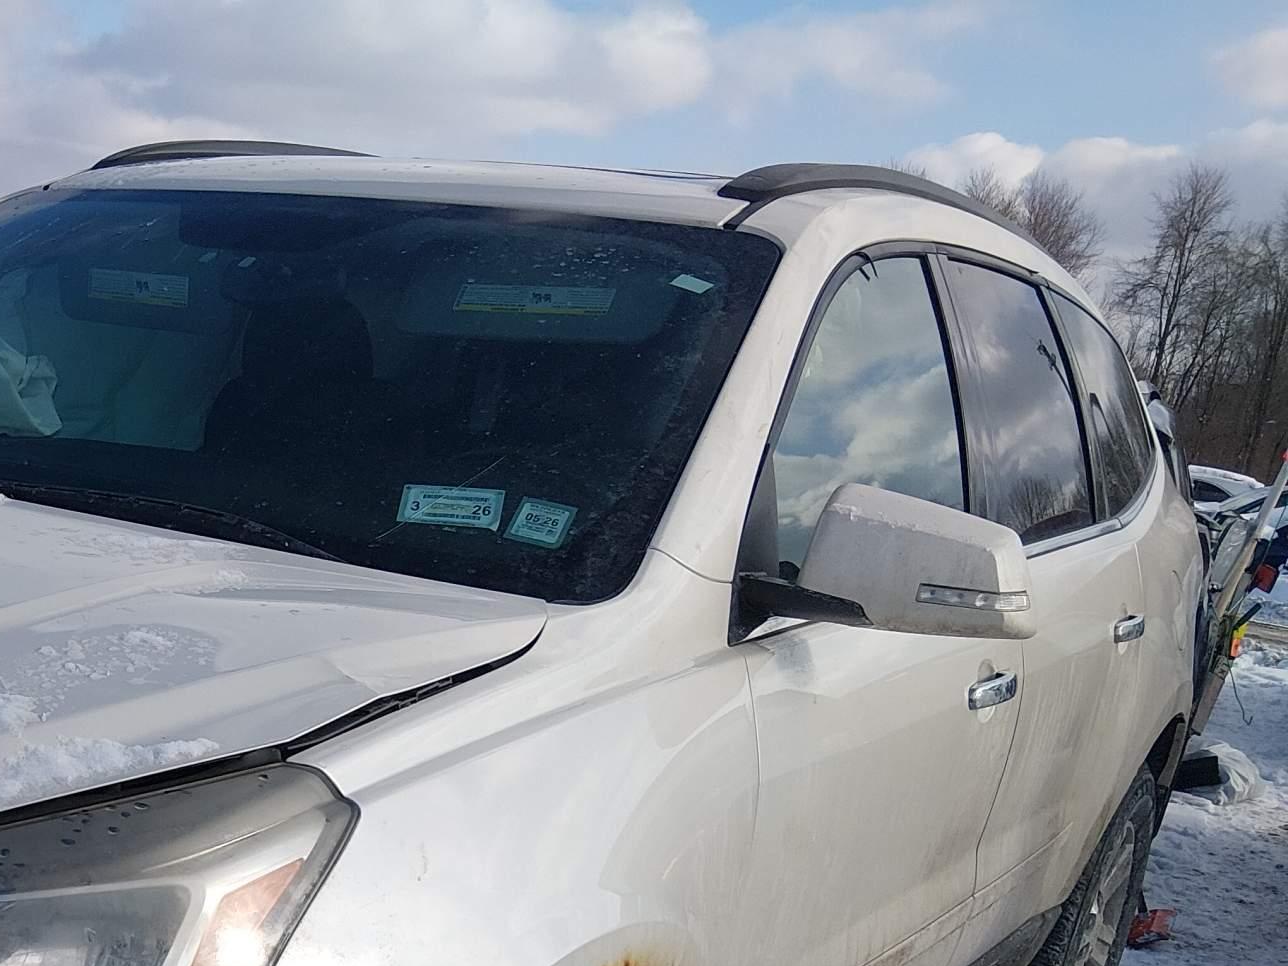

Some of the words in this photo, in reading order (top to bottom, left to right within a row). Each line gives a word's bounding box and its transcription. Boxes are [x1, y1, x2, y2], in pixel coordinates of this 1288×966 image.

[410, 500, 421, 511] 3
[472, 504, 492, 517] 26
[525, 512, 541, 523] 05
[543, 516, 560, 527] 26
